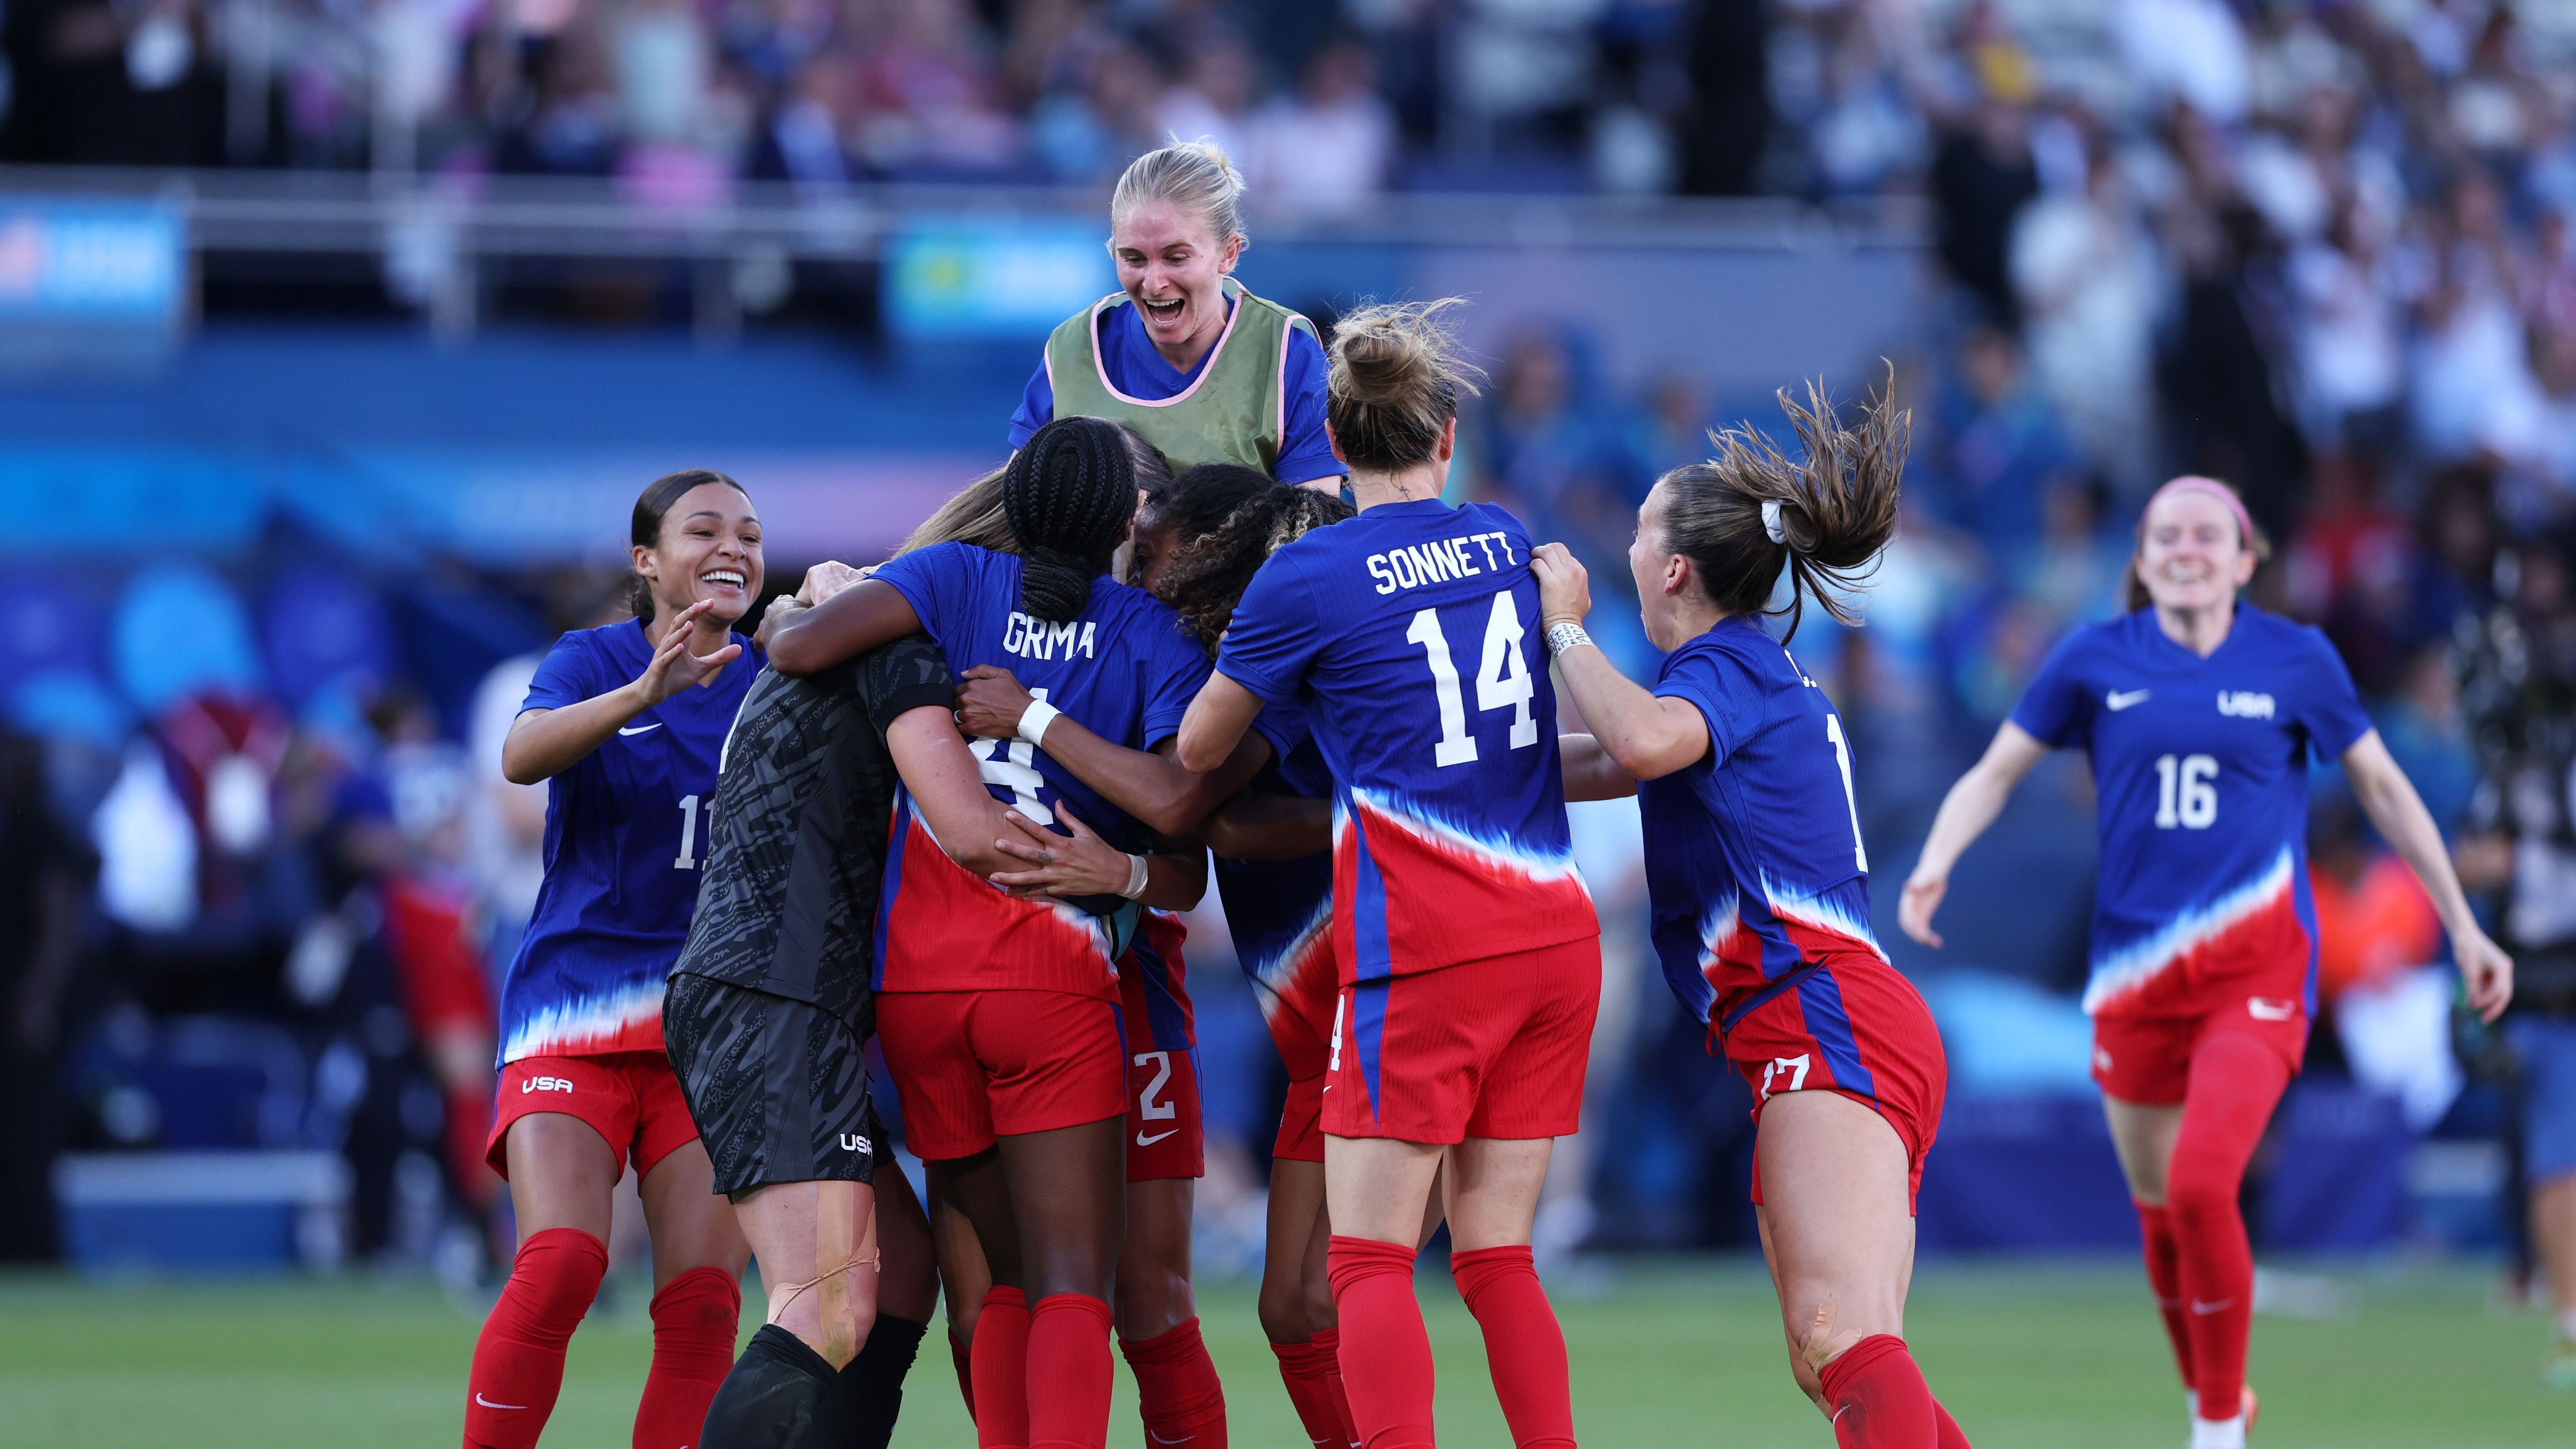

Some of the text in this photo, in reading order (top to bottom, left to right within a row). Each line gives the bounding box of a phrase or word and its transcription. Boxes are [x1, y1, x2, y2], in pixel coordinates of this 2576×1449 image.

[1366, 531, 1517, 595] SONNETT
[1406, 590, 1538, 767] 14
[968, 687, 1054, 826] 4
[2155, 754, 2219, 830] 16
[522, 1076, 573, 1094] USA
[1134, 1051, 1175, 1121] 2
[1761, 1053, 1810, 1101] 17
[840, 1133, 873, 1158] USA
